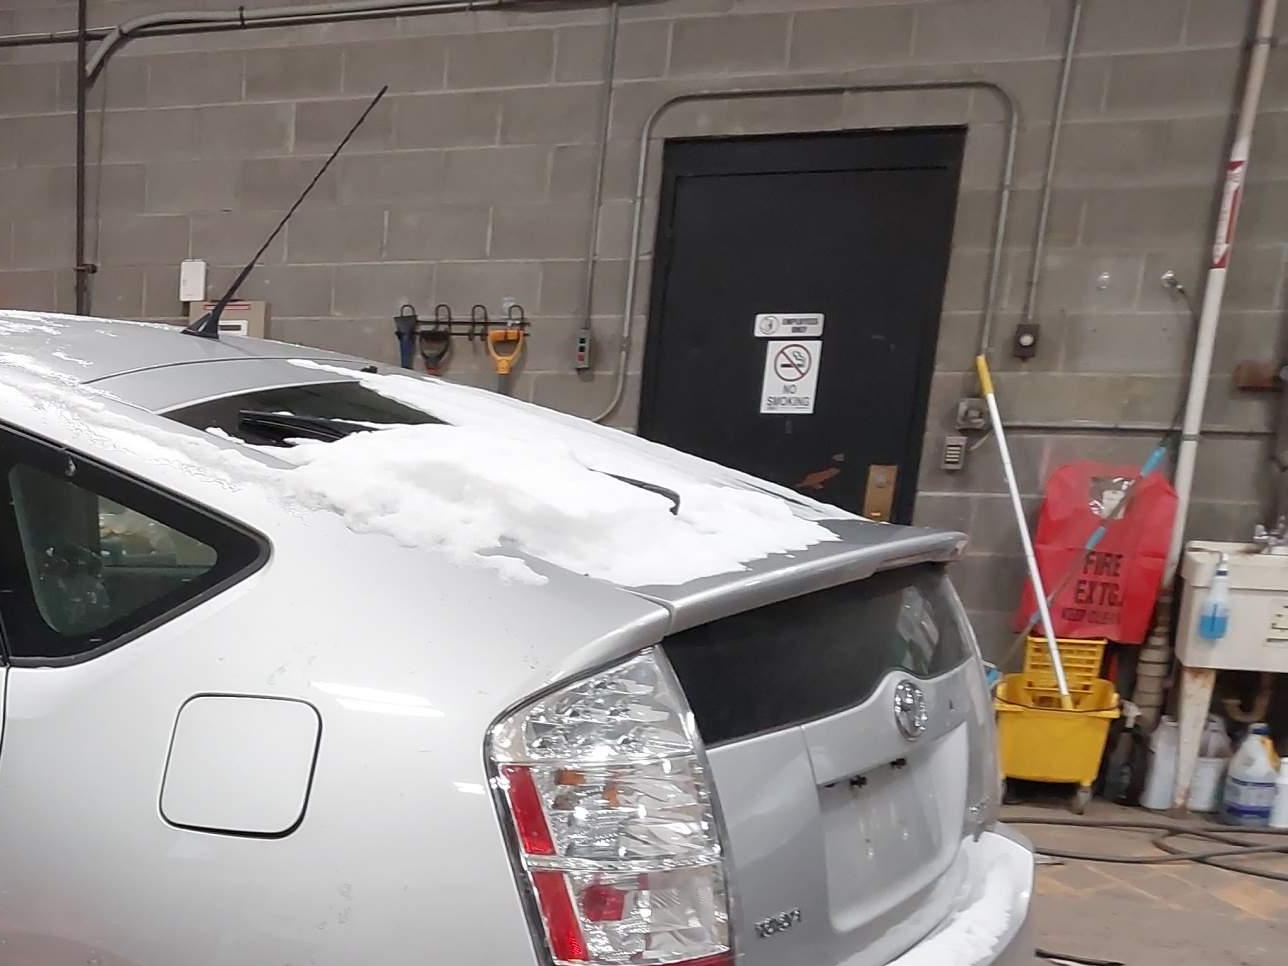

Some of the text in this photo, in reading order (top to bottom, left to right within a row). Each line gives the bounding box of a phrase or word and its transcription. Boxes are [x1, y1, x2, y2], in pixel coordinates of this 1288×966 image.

[783, 383, 798, 395] NO
[767, 396, 811, 407] SMOKING
[1083, 551, 1123, 577] FIRE
